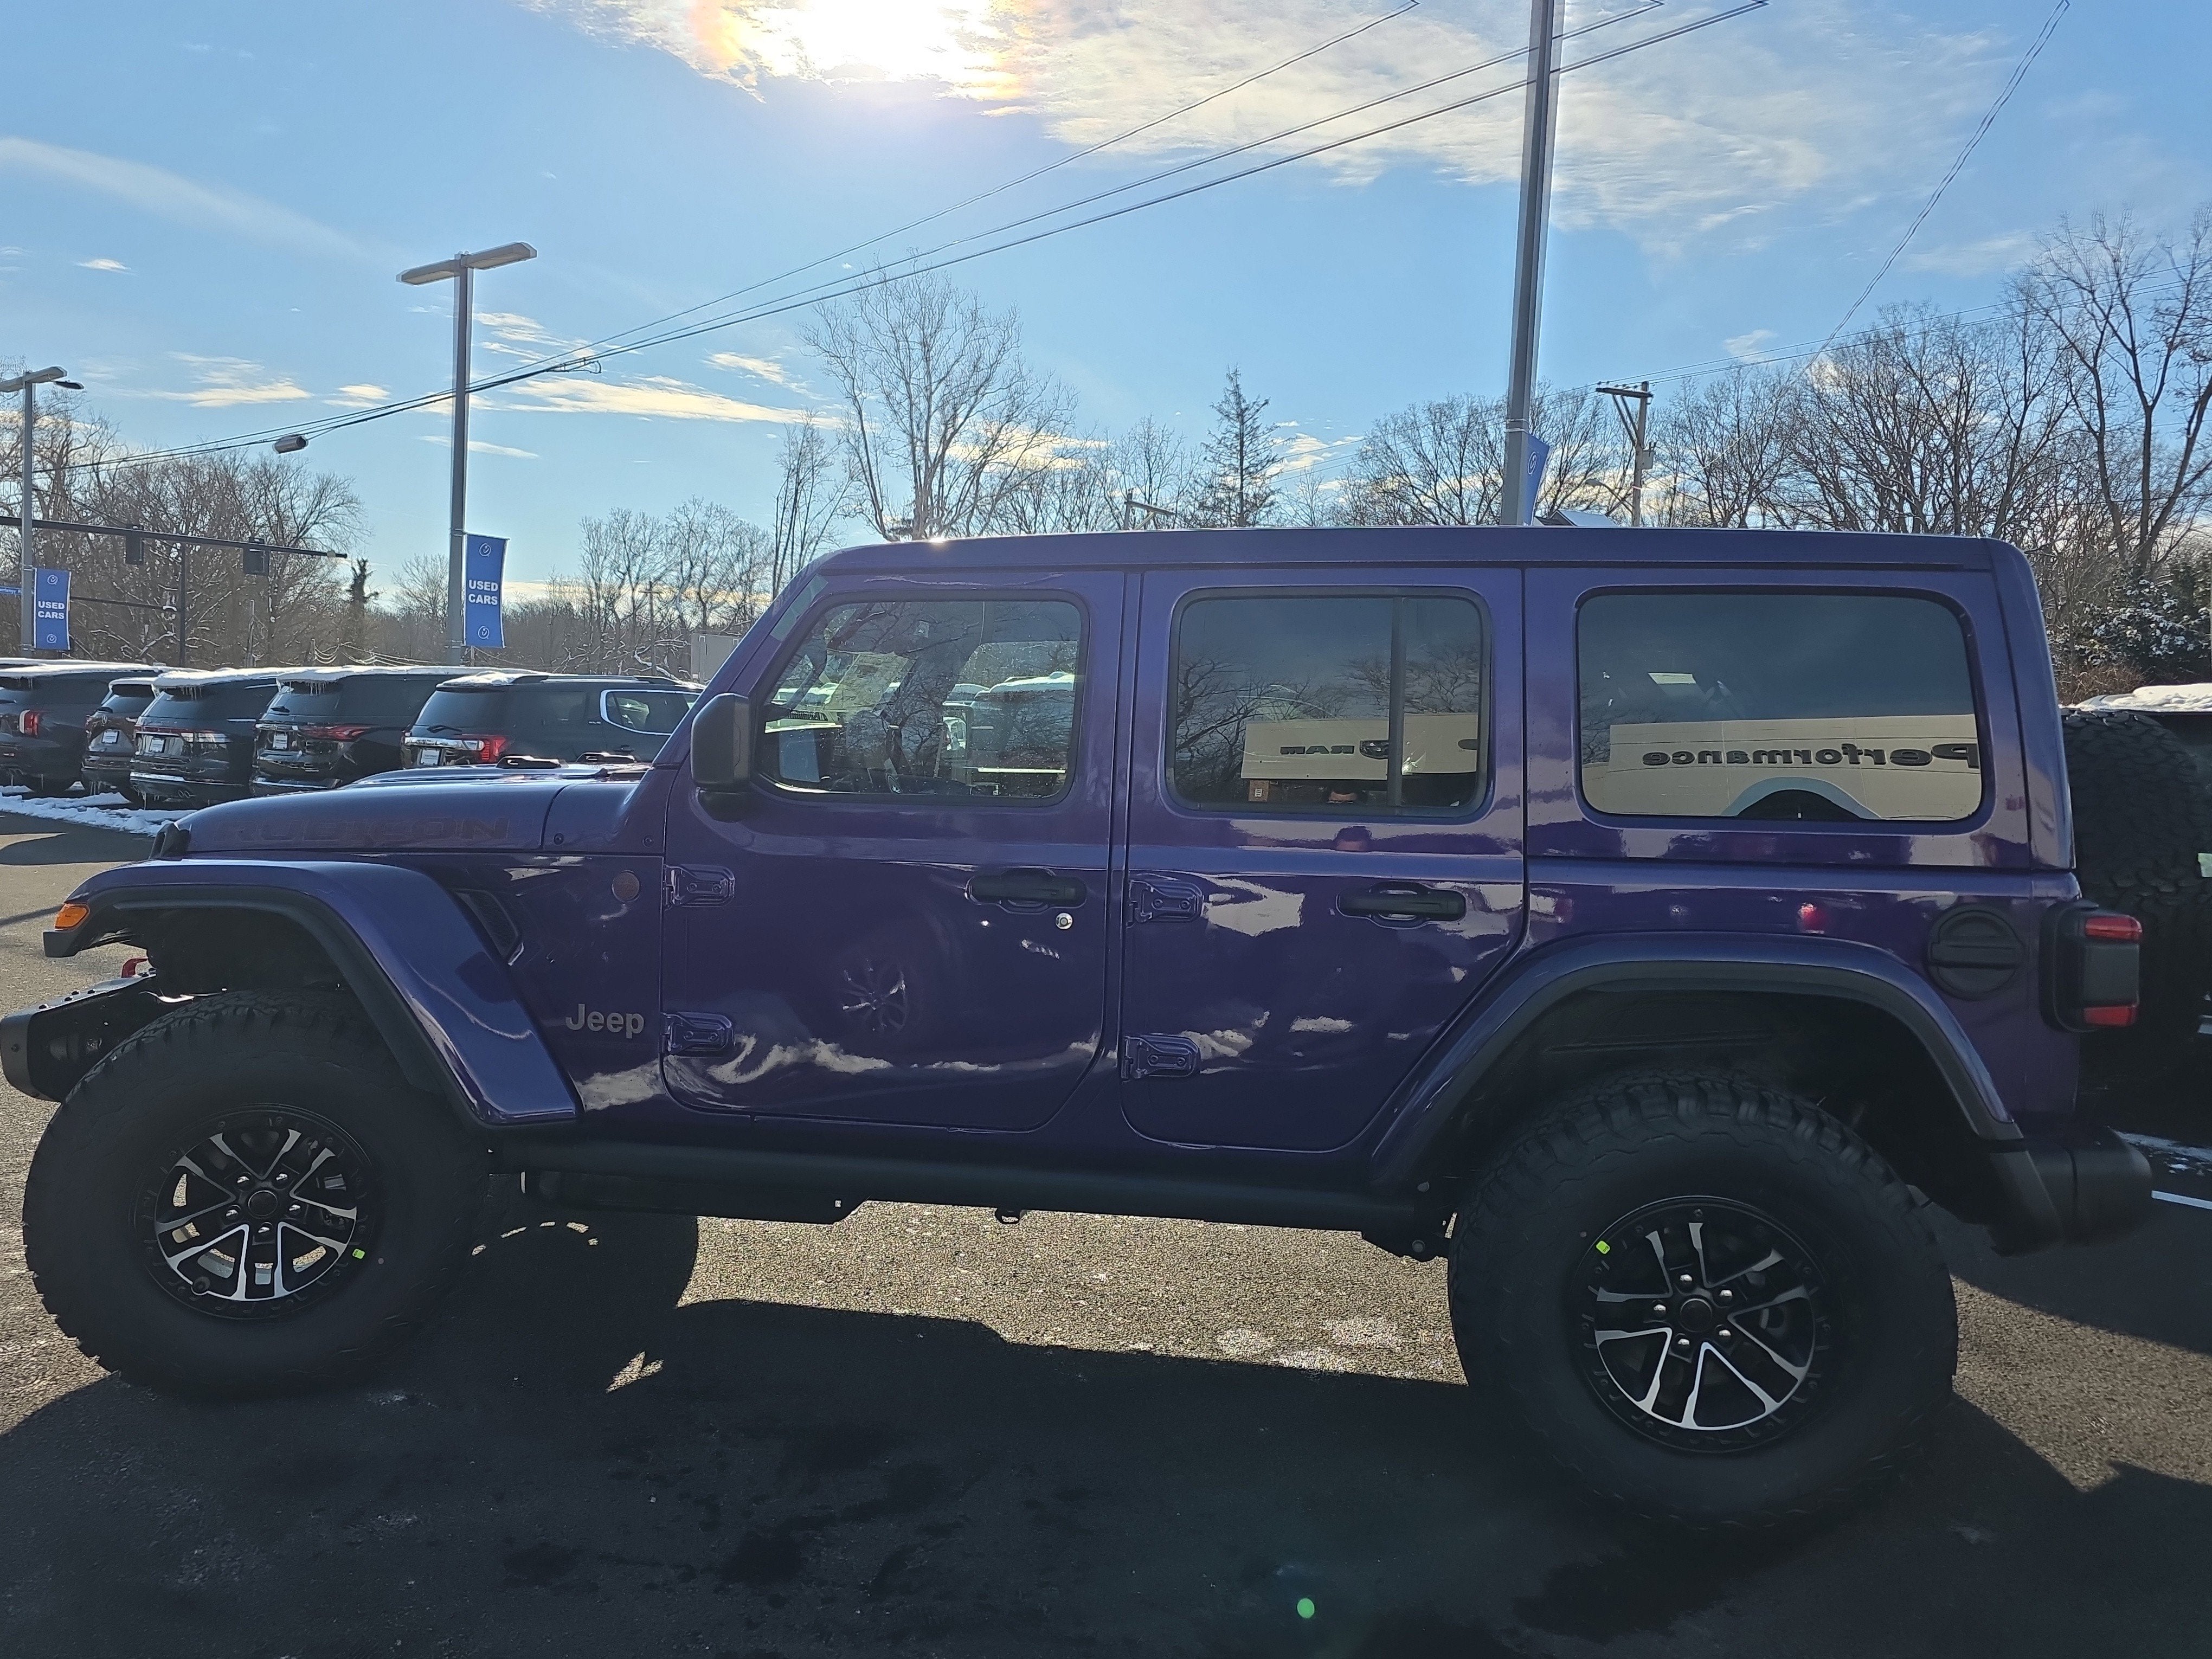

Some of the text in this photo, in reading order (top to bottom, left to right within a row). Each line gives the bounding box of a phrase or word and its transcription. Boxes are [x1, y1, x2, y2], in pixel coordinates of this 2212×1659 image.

[468, 580, 498, 591] USED
[38, 601, 65, 609] USED
[468, 593, 498, 606] CARS
[37, 610, 65, 620] CARS
[213, 817, 509, 841] RUBICON
[565, 1003, 645, 1039] Jeep
